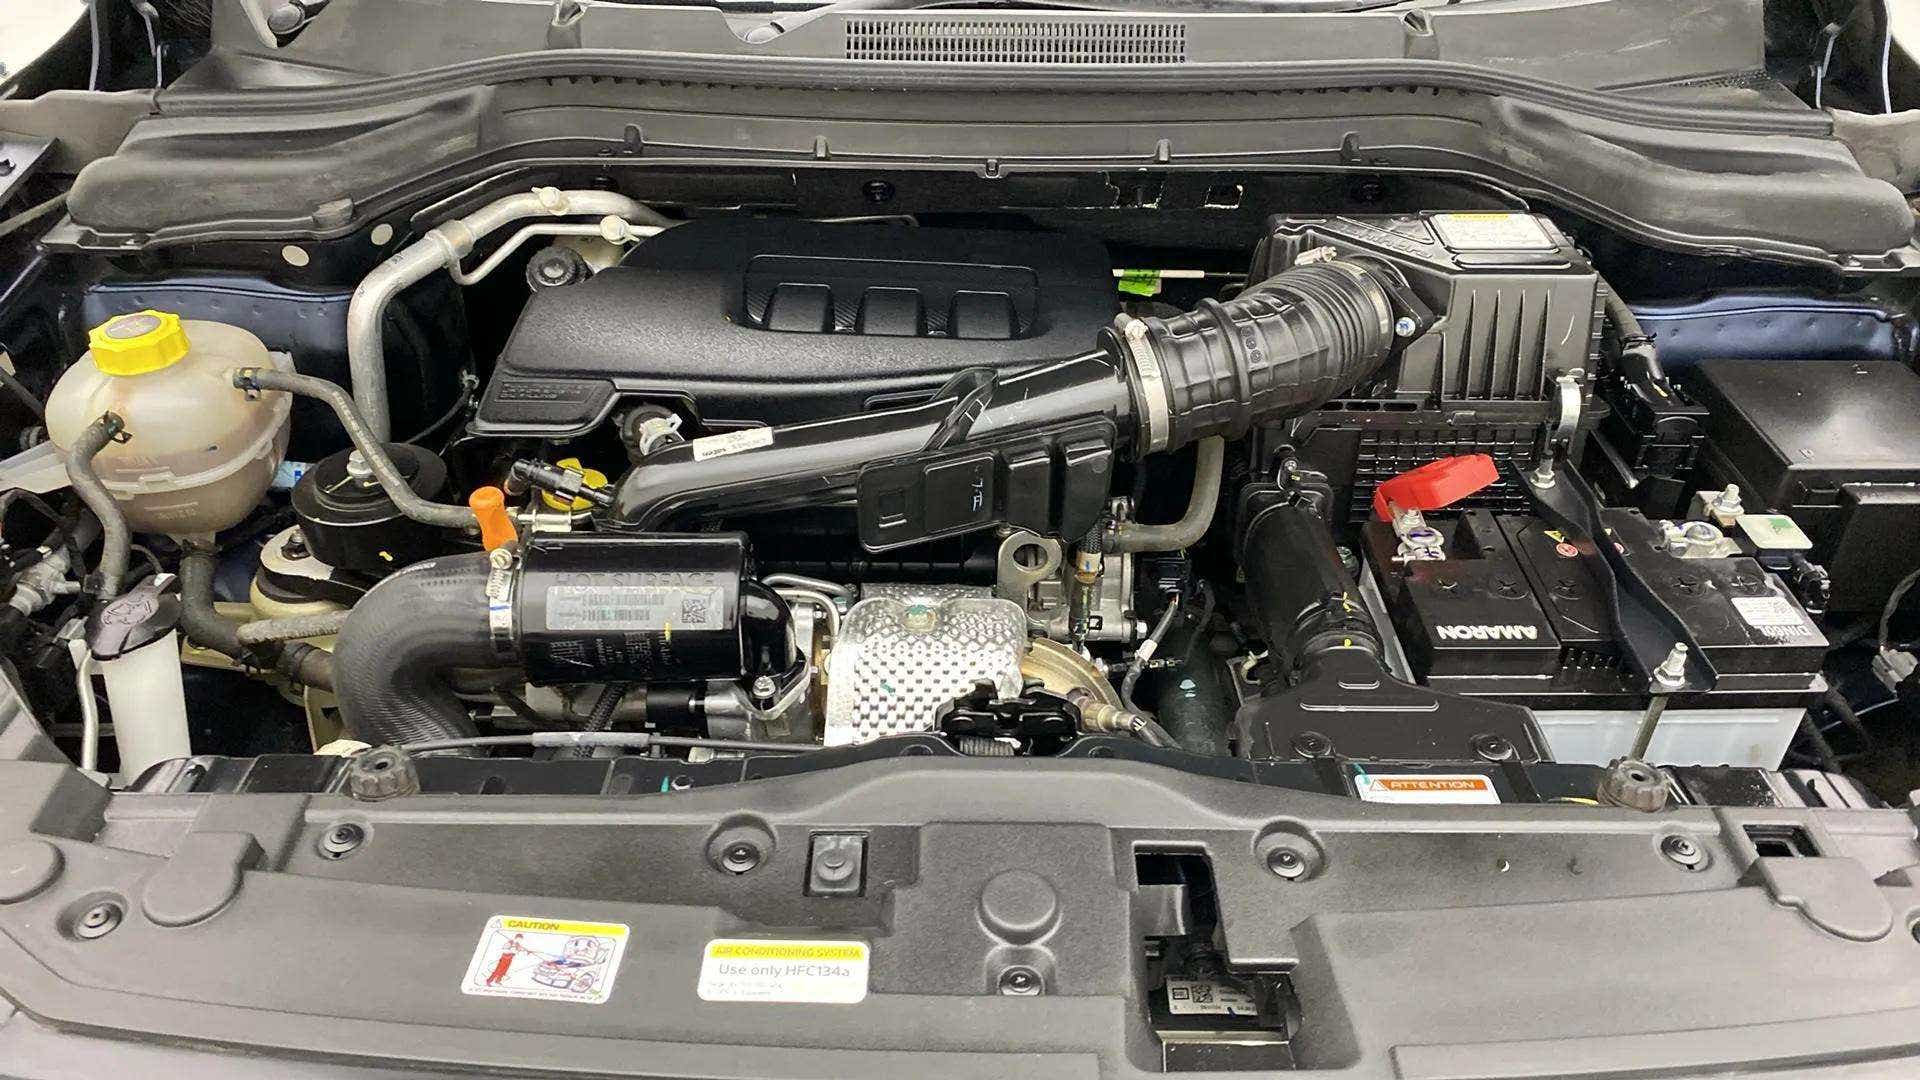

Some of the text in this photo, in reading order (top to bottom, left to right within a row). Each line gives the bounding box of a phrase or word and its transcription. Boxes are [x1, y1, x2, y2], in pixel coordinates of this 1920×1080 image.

[1436, 625, 1538, 640] AMARON
[1390, 780, 1476, 790] ATTENTION
[508, 919, 560, 931] CAUTION
[735, 946, 814, 958] CONDITIONING
[816, 947, 861, 958] SYSTEM
[719, 964, 850, 978] Use only HFC134a
